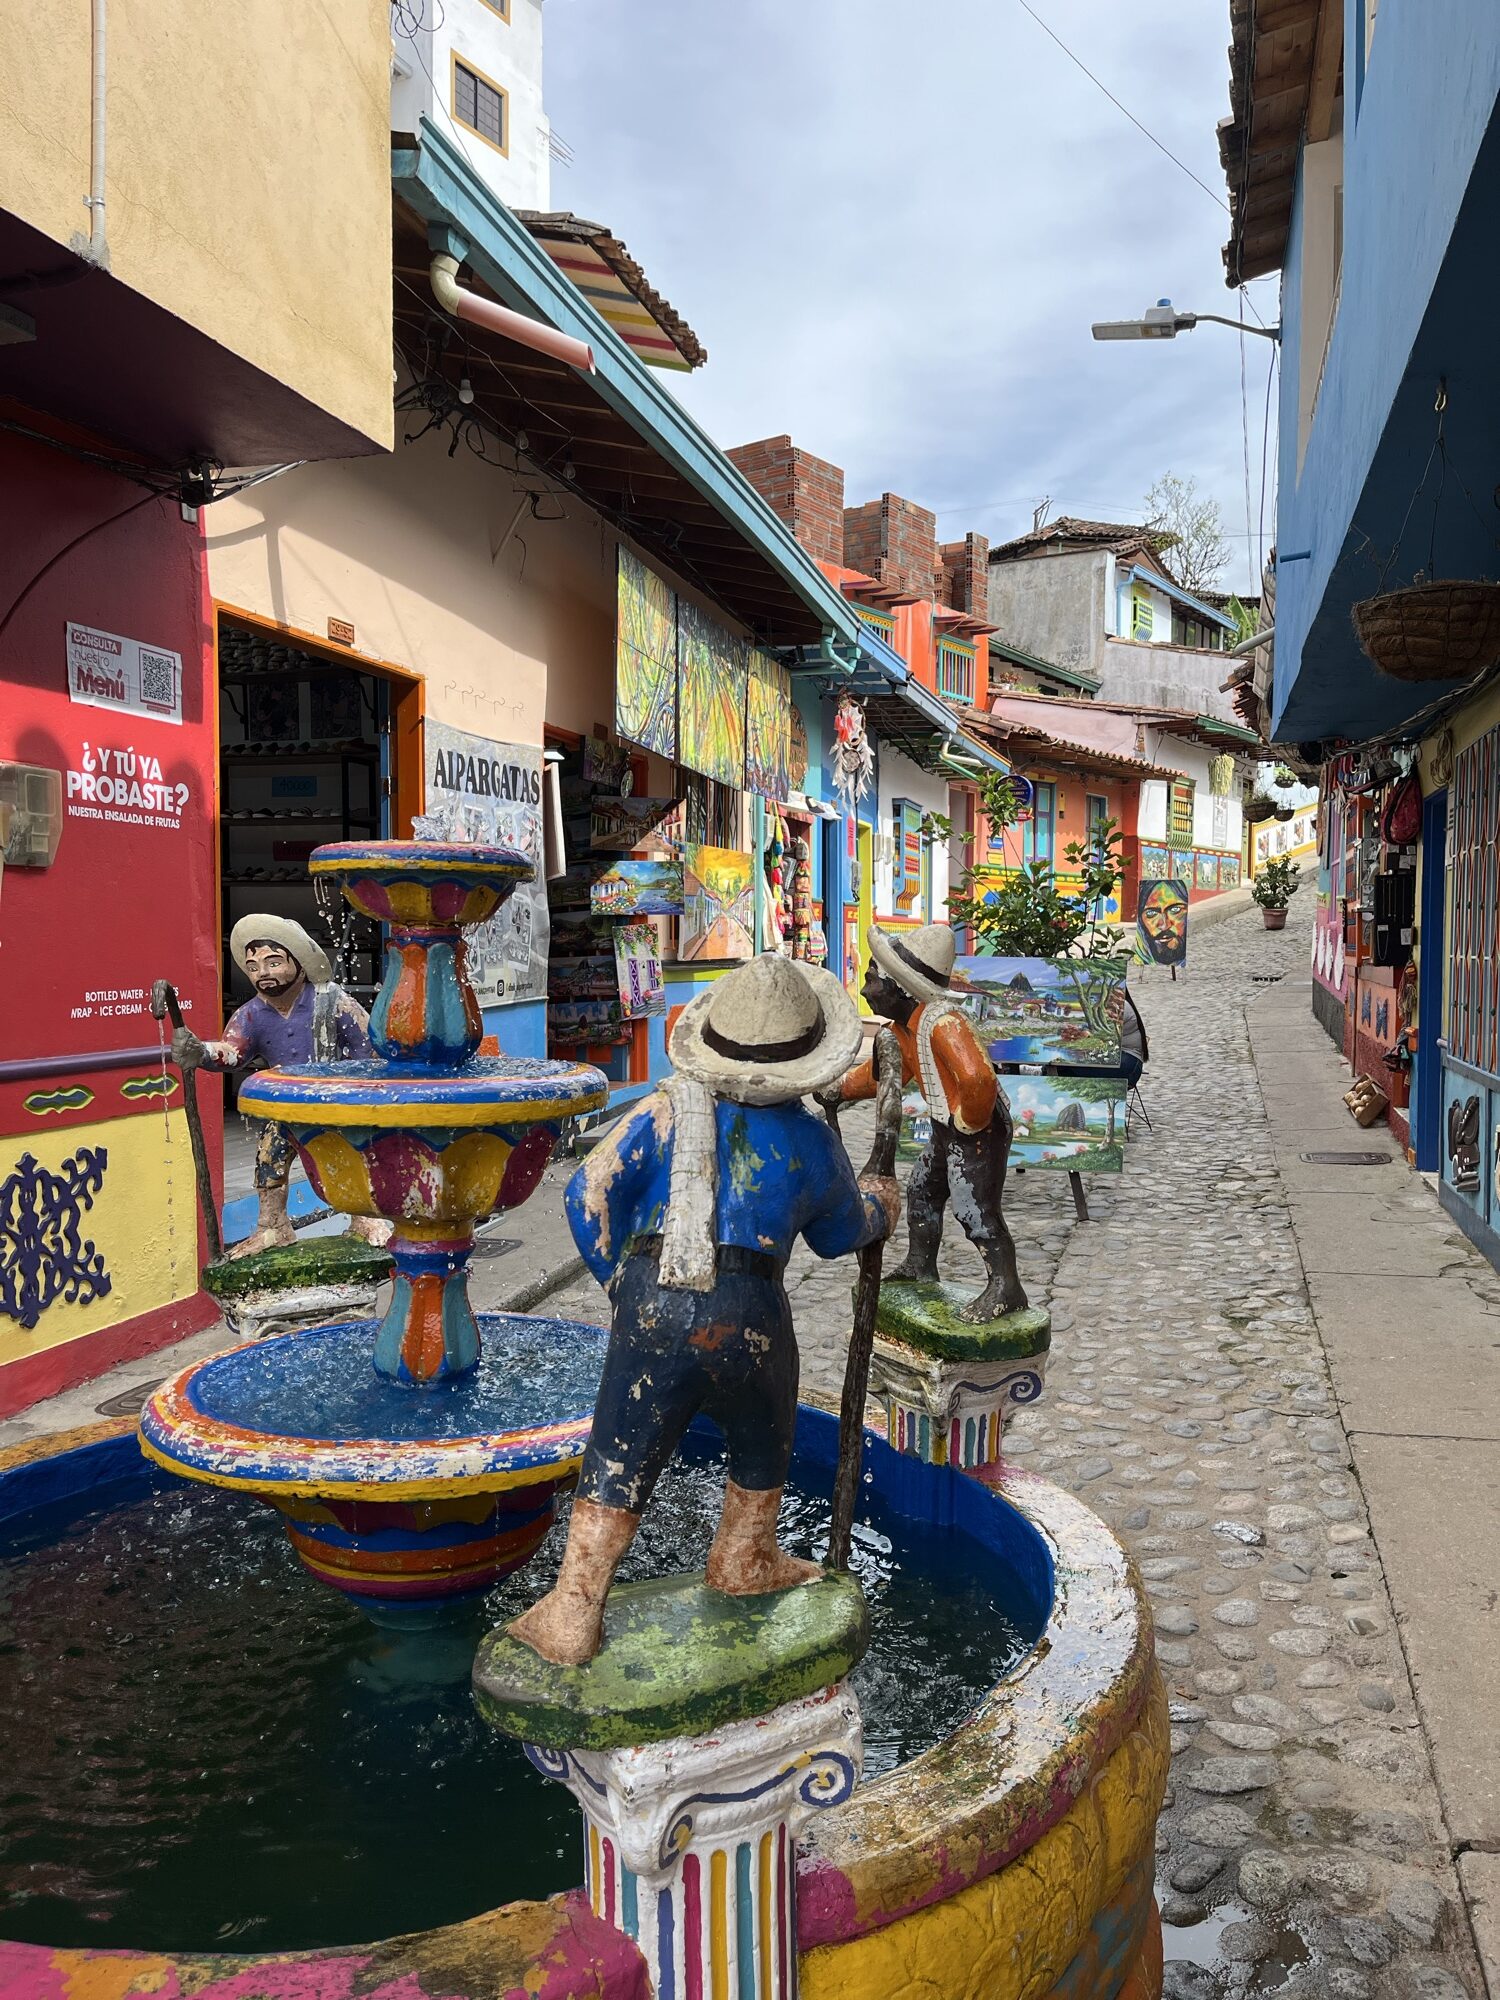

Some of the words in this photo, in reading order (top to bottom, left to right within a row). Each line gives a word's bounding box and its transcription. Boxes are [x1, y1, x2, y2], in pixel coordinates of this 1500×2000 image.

[74, 631, 118, 653] CONSULTA
[75, 649, 110, 667] nuestro
[77, 664, 125, 701] Menú
[114, 746, 136, 777] TÚ
[138, 755, 163, 782] YA
[66, 770, 189, 816] PROBASTE?
[68, 805, 103, 820] NUESTRA
[105, 810, 144, 825] ENSALADA
[145, 816, 155, 826] DE
[155, 817, 180, 829] FRUTAS
[85, 990, 118, 1002] BOTTLED
[120, 989, 144, 1000] WATER
[99, 1005, 113, 1016] ICE
[115, 1004, 142, 1015] CREAM
